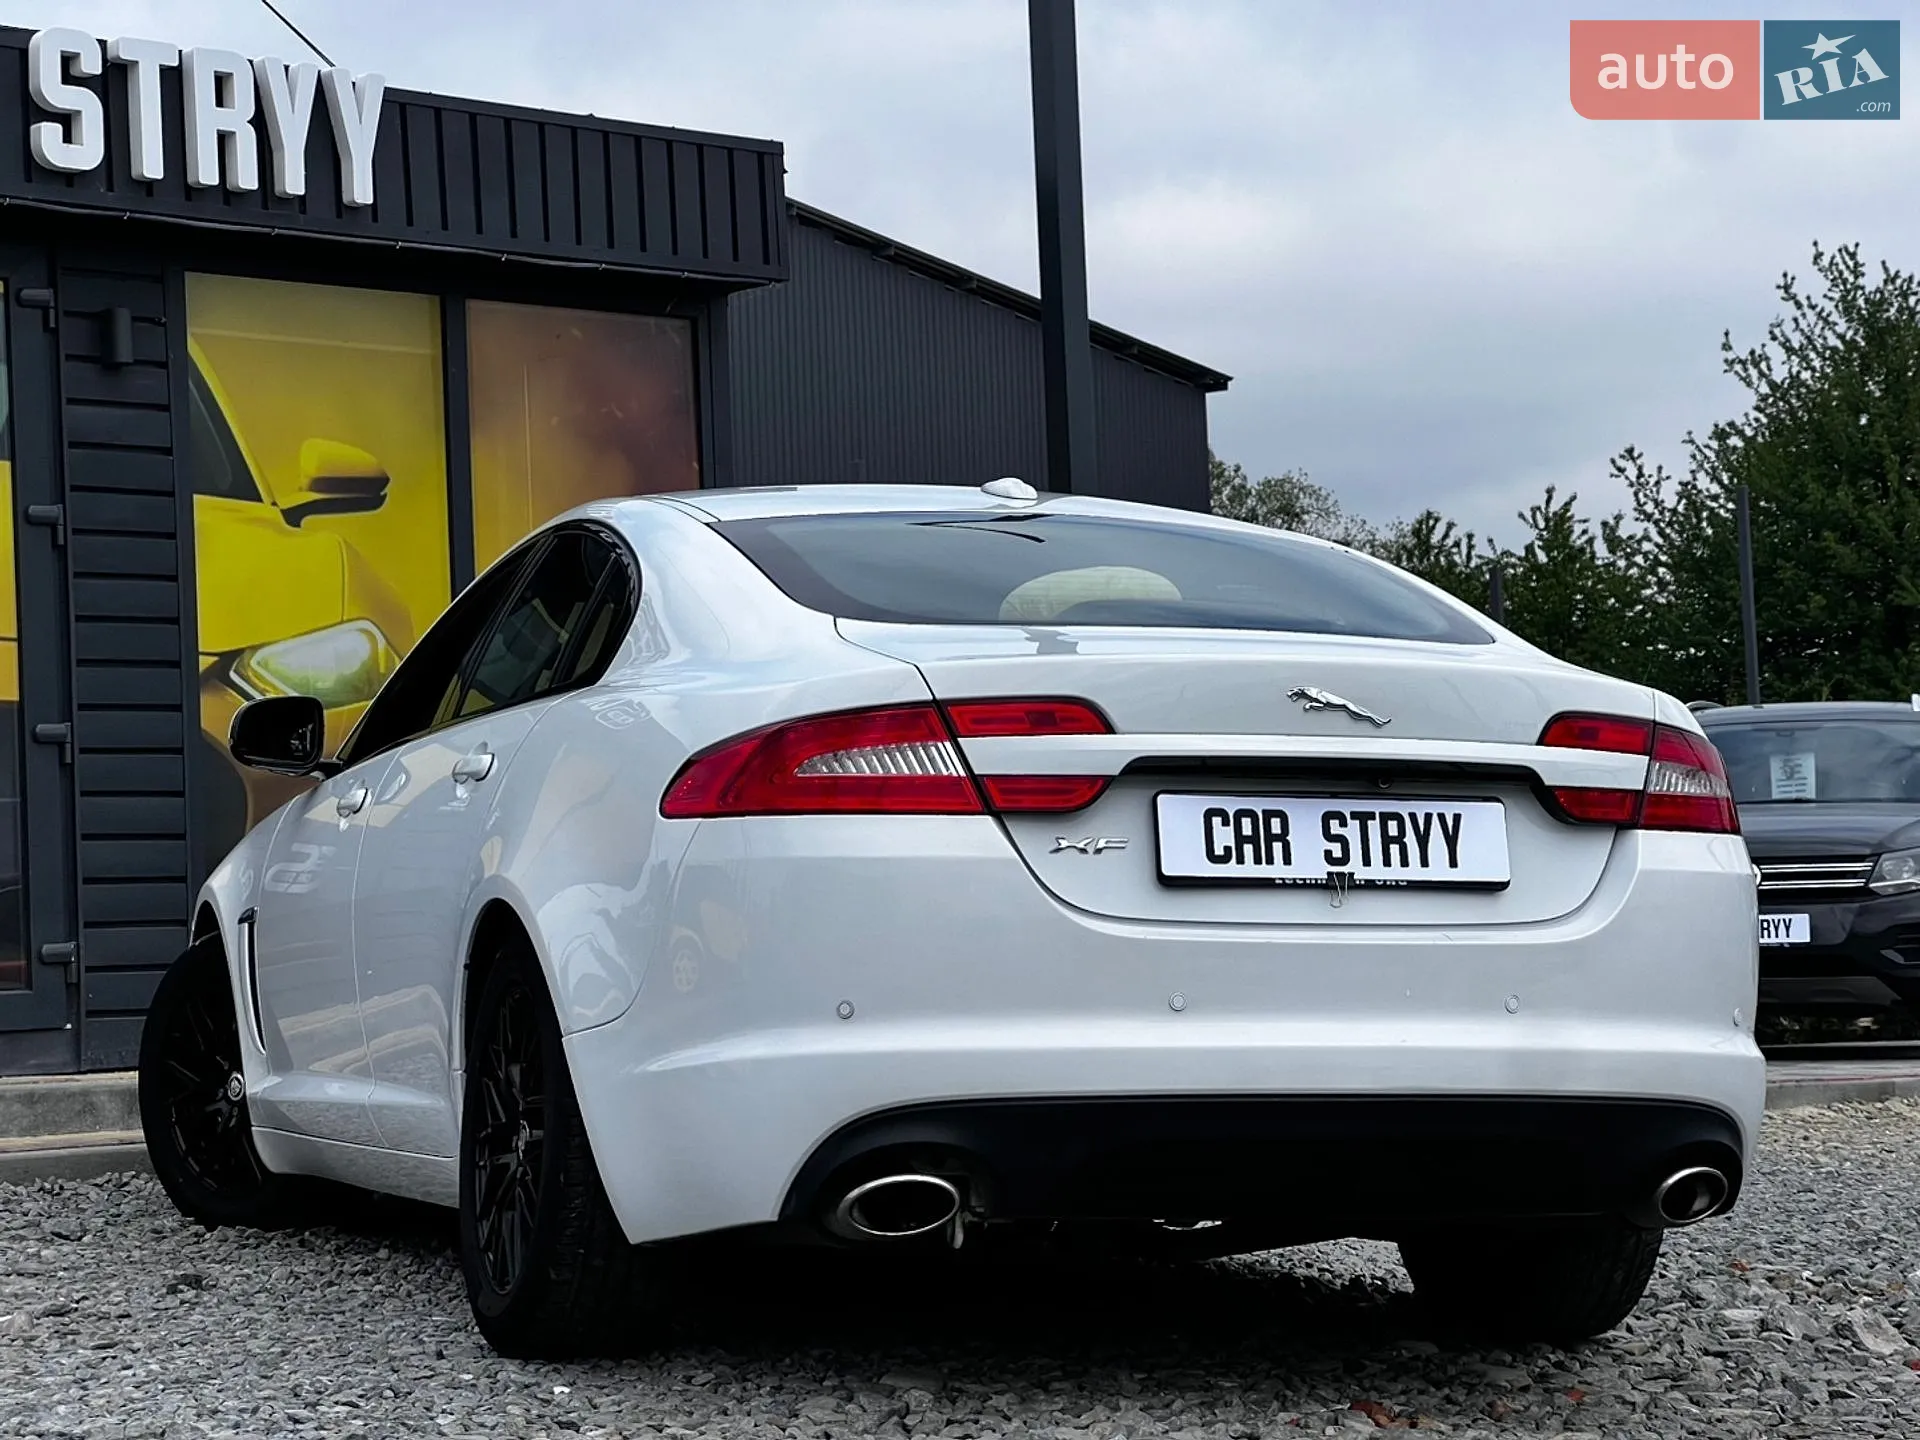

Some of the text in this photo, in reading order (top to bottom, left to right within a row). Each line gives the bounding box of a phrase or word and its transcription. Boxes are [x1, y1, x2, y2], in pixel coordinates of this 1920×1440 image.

[28, 27, 385, 207] STRYY
[1049, 836, 1128, 854] XF
[1203, 807, 1462, 868] CAR STRYY
[1760, 918, 1792, 938] RYY
